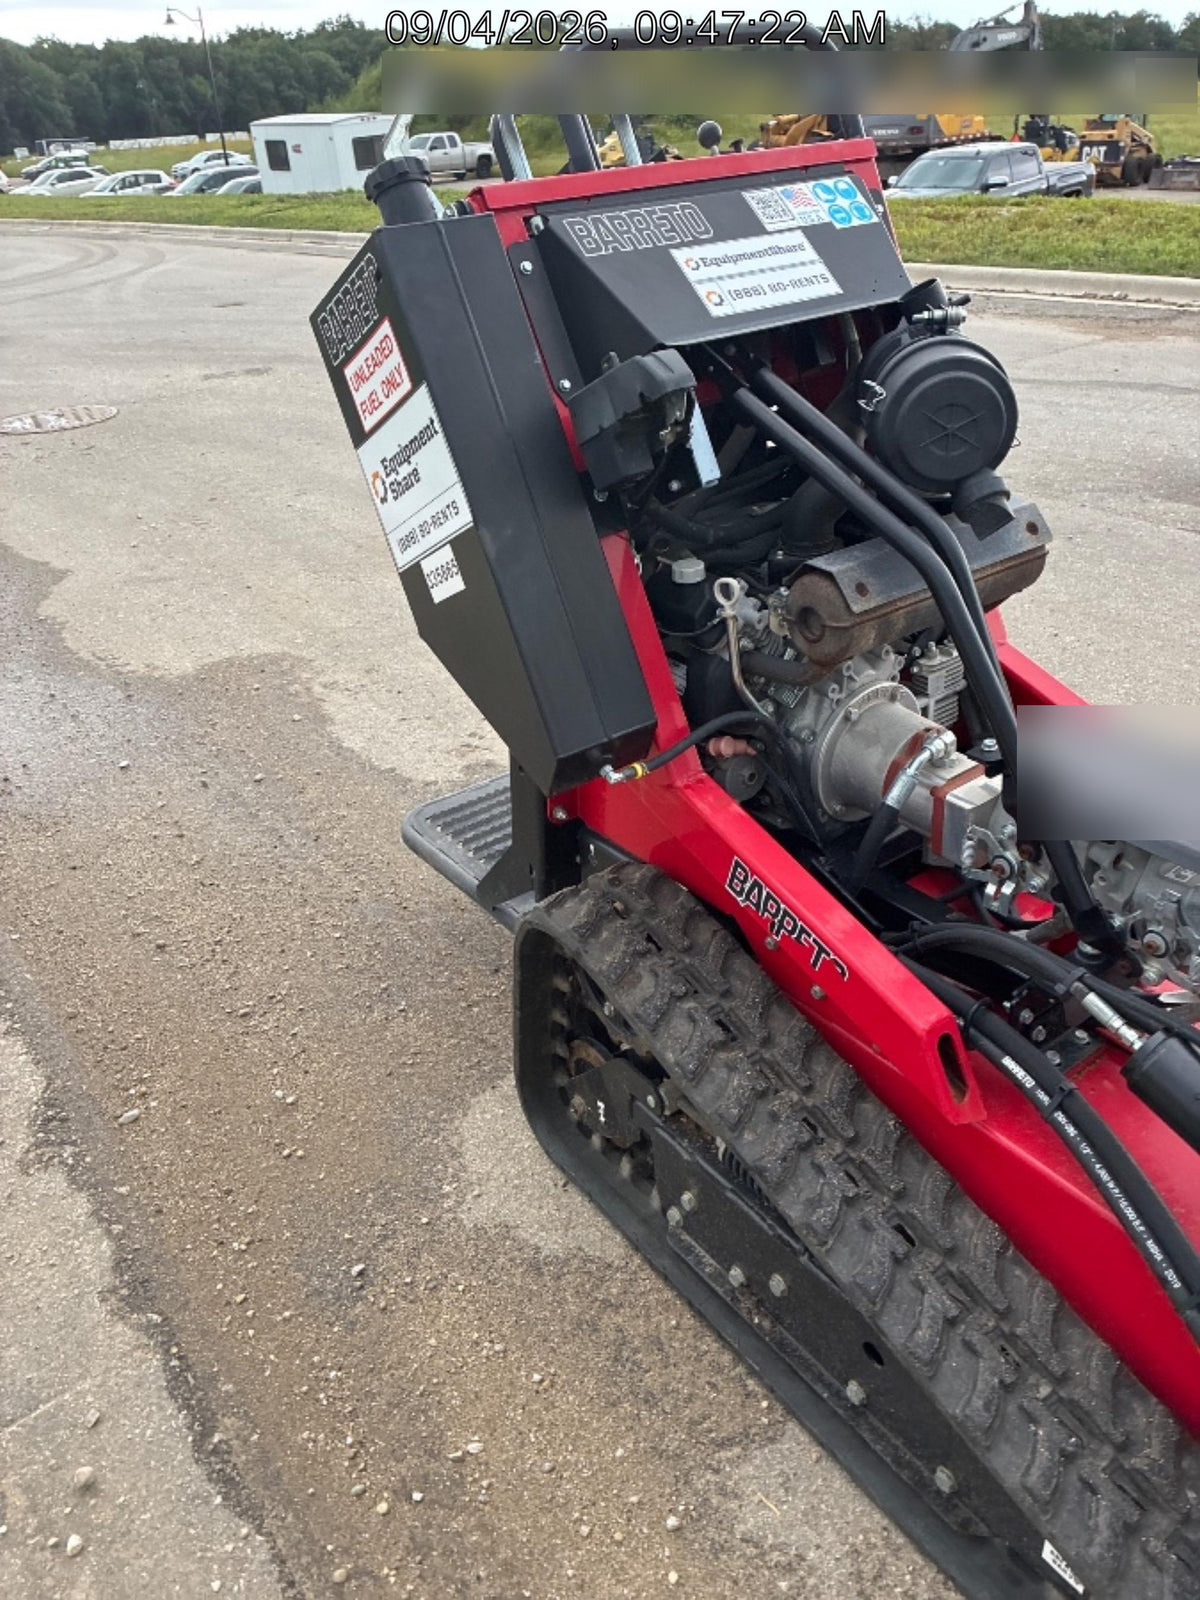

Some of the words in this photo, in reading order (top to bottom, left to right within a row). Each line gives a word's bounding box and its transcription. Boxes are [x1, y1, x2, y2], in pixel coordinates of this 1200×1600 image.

[1082, 145, 1107, 163] CAT
[563, 202, 714, 256] BARRETO
[700, 242, 806, 269] EquipmentShare
[728, 284, 768, 301] (888)
[350, 334, 394, 393] UNLEADED
[360, 390, 383, 421] FUEL
[380, 363, 405, 399] ONLY
[380, 416, 440, 478] Equipment
[388, 466, 421, 502] Share
